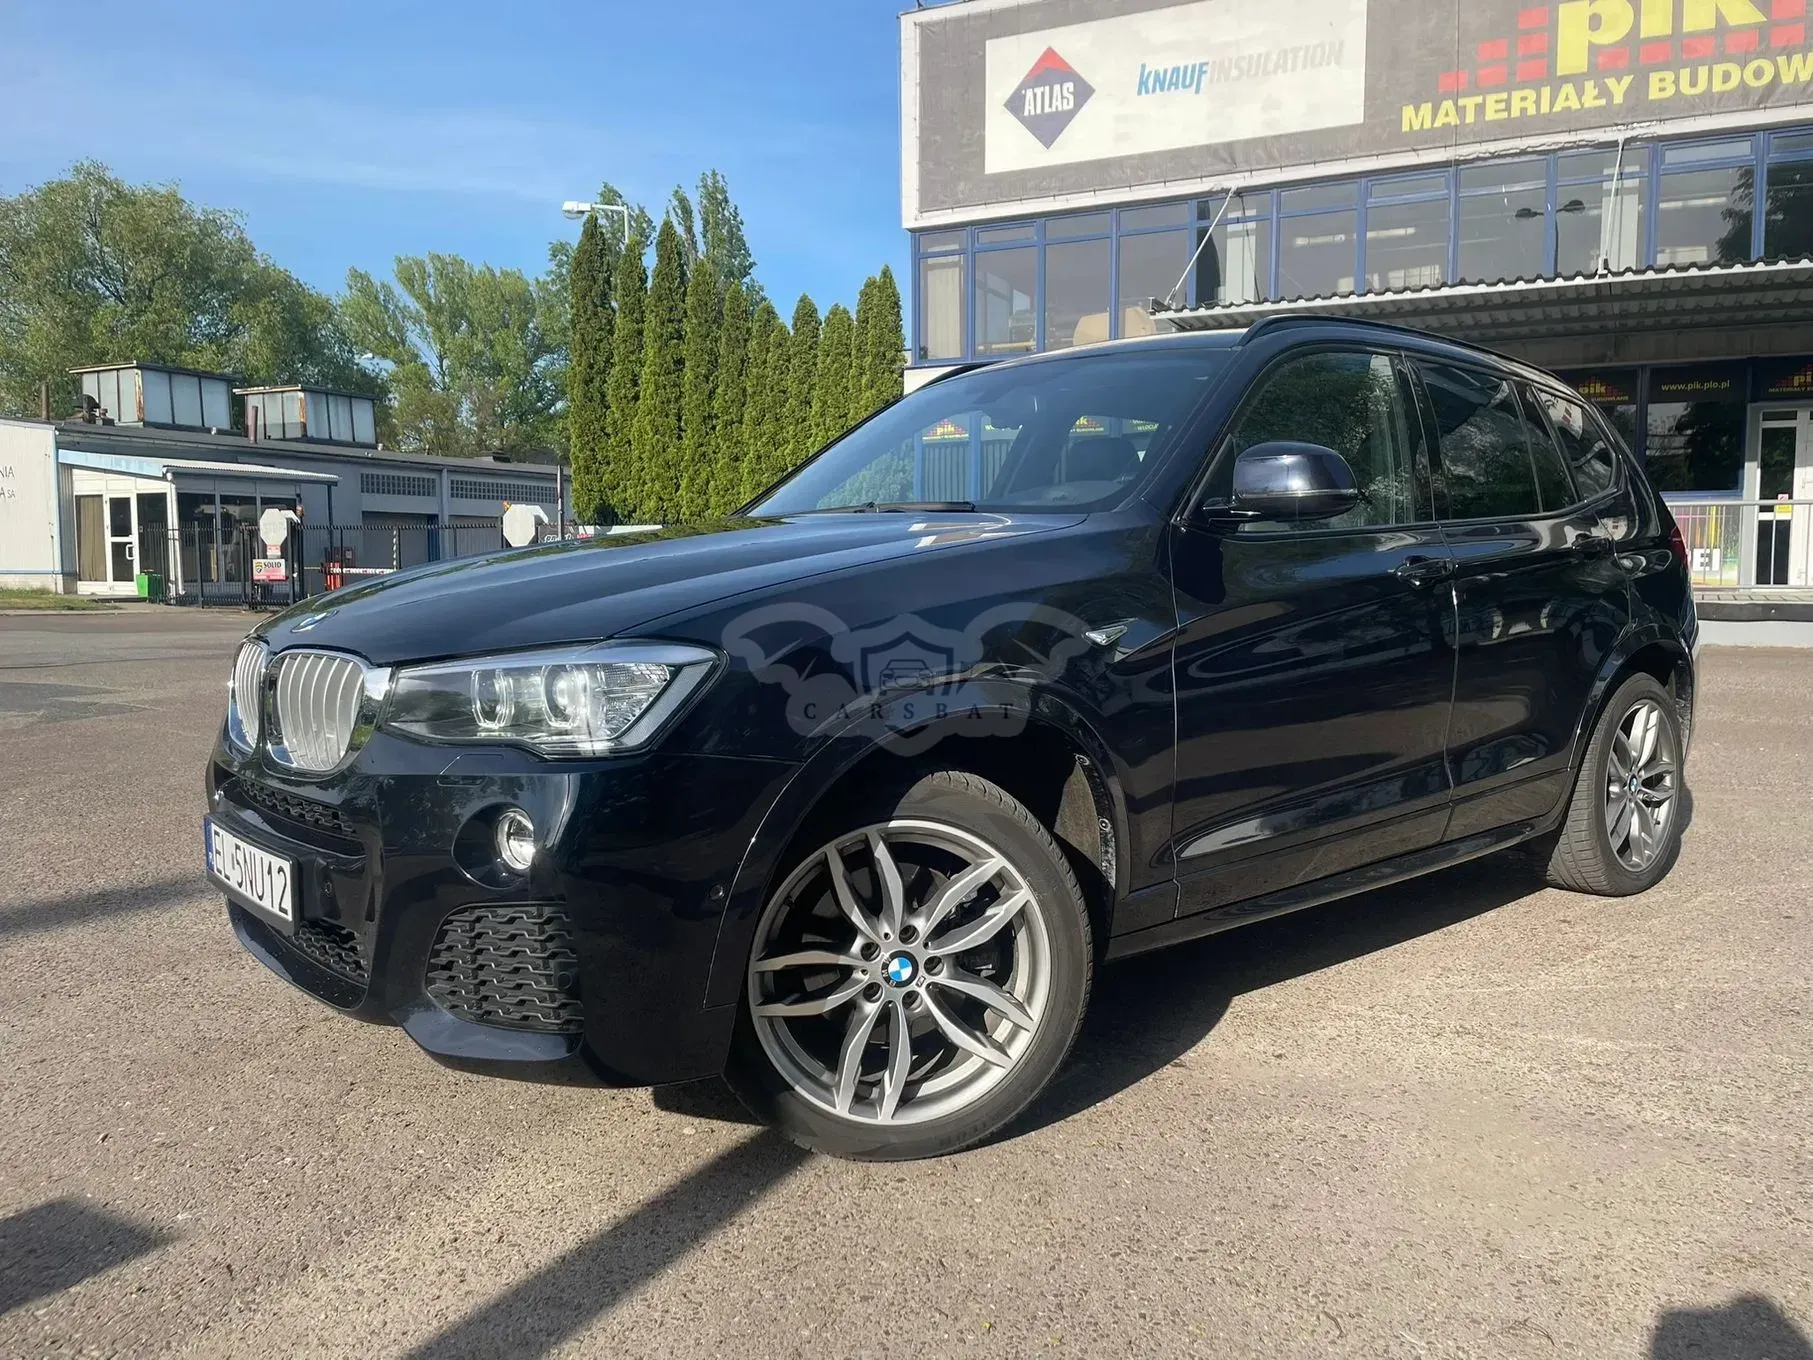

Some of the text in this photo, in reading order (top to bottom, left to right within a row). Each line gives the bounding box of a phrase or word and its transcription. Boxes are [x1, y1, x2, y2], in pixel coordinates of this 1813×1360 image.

[1209, 39, 1344, 85] INSULATION
[1023, 81, 1074, 116] ATLAS
[1401, 75, 1633, 132] MATERIAŁY
[263, 560, 282, 569] SOLID
[214, 830, 288, 916] EL 5NU12
